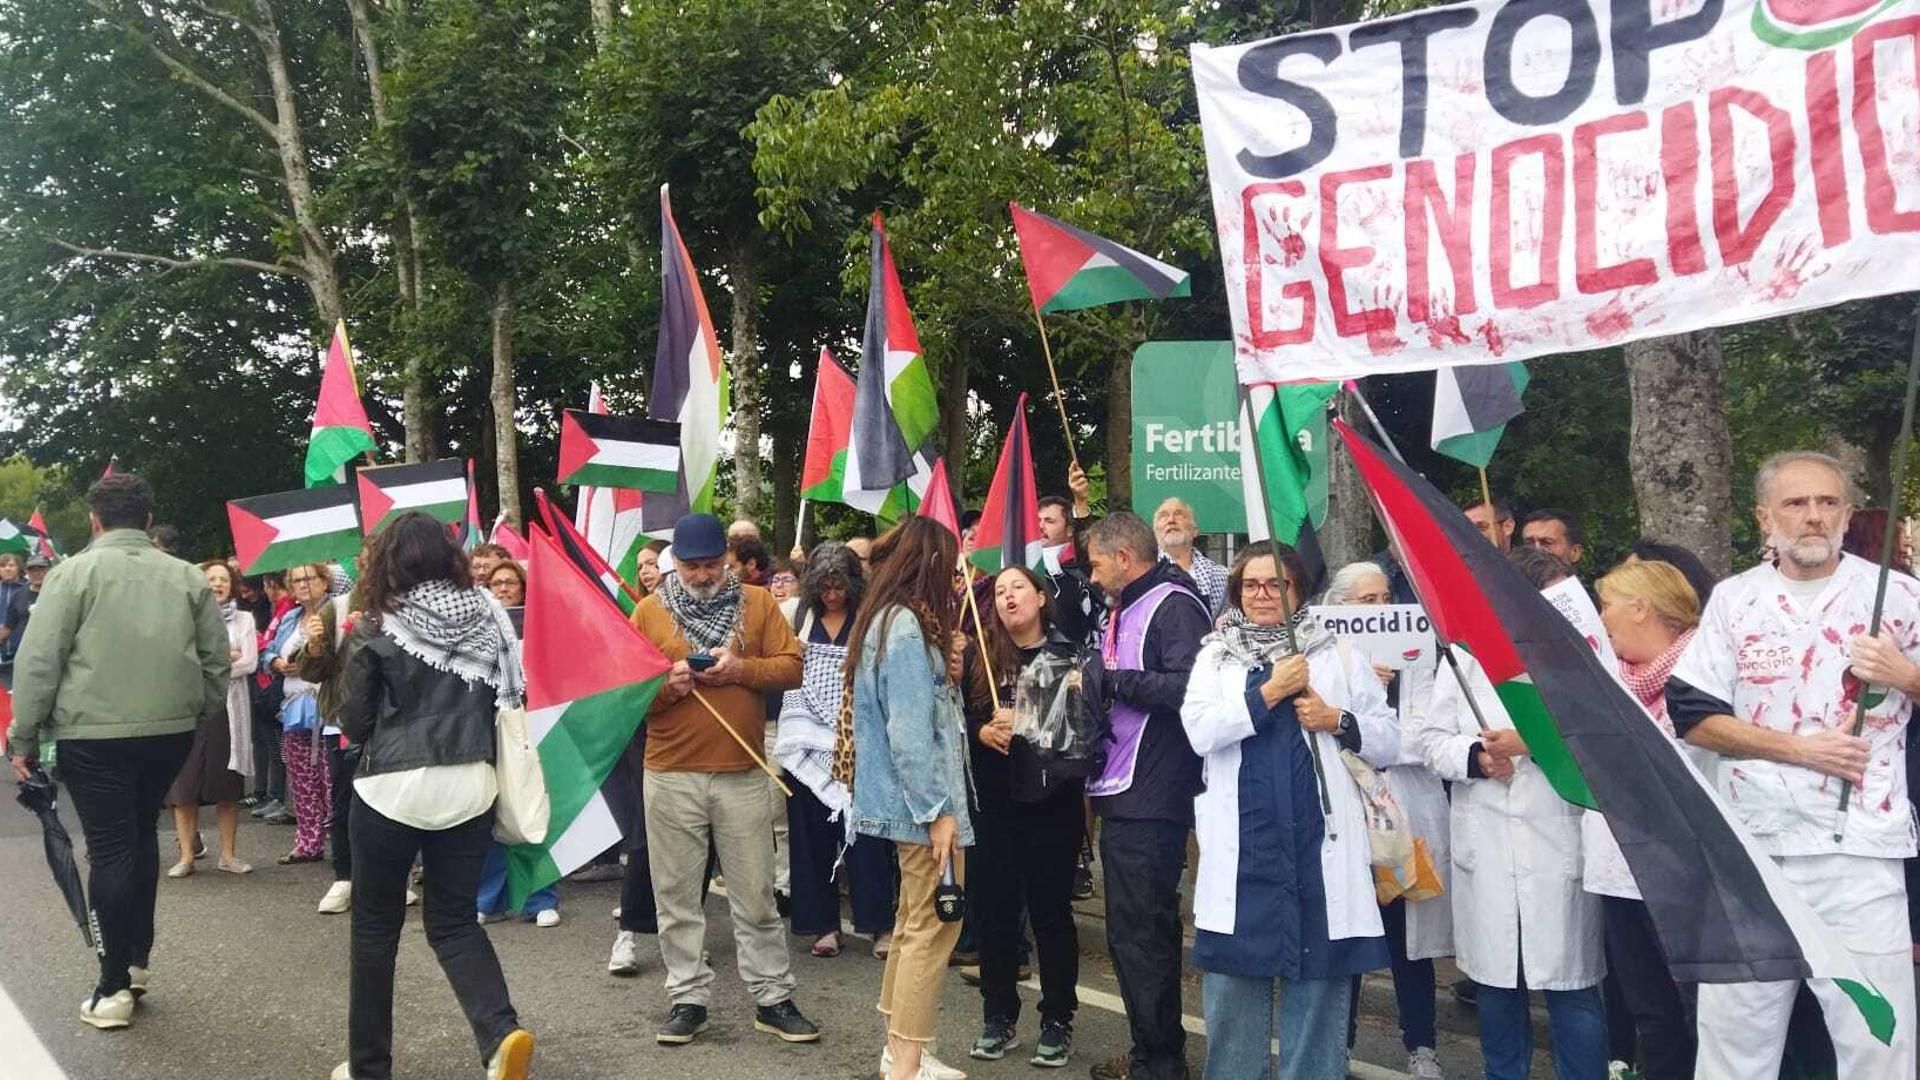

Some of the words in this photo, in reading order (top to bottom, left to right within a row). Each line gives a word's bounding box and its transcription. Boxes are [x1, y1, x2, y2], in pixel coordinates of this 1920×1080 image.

[1236, 0, 1724, 178] STOP
[1241, 15, 1920, 352] GENOCIDIO
[1146, 421, 1312, 452] Fertiba
[1147, 464, 1245, 481] Fertilizante
[1317, 611, 1430, 634] enocidio
[1739, 646, 1791, 660] STOP
